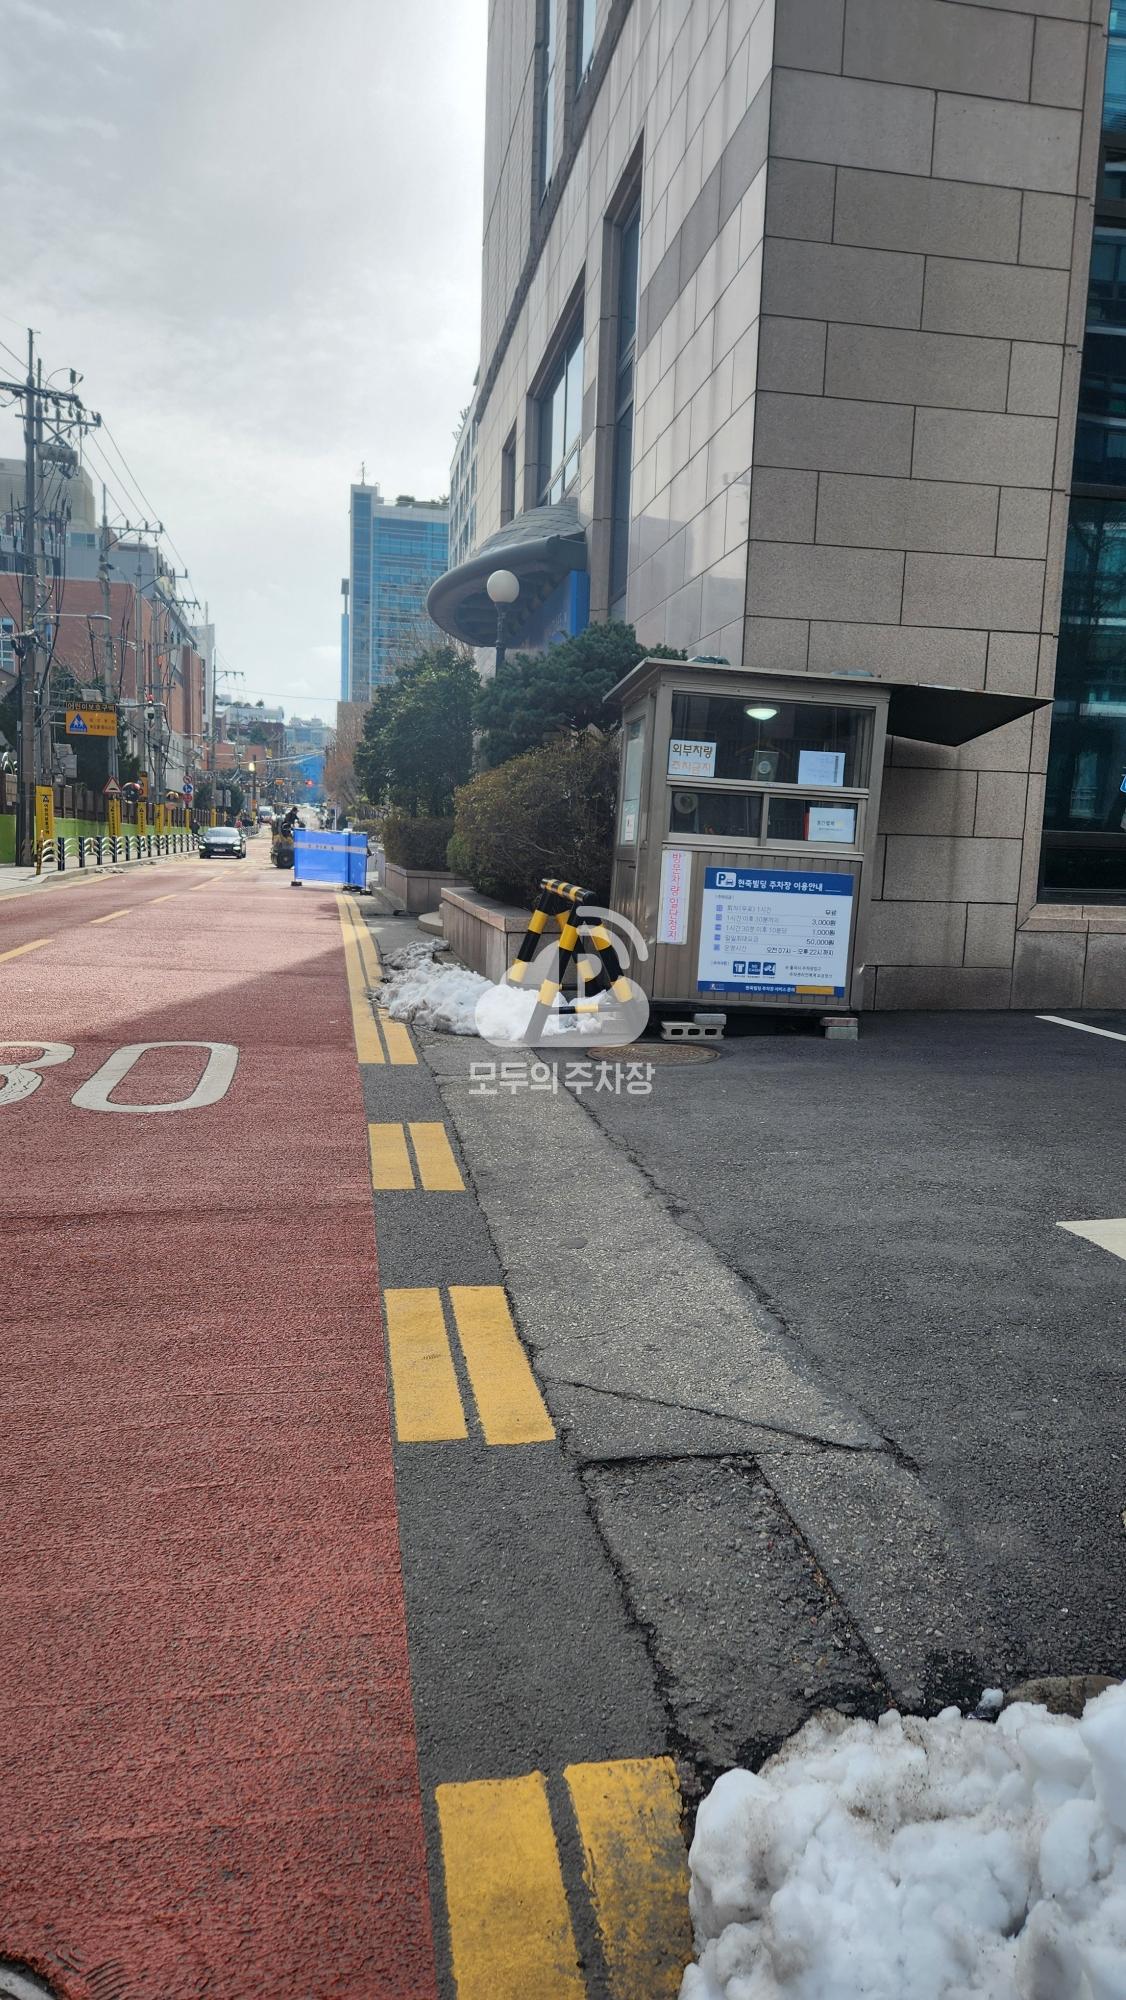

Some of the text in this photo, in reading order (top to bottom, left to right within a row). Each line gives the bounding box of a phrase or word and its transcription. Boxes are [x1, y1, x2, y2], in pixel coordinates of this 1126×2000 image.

[673, 743, 713, 759] 외부차량
[769, 880, 792, 892] 주차장
[793, 882, 823, 892] 이용안내
[825, 909, 837, 917] 무료
[806, 938, 835, 946] 50,000원
